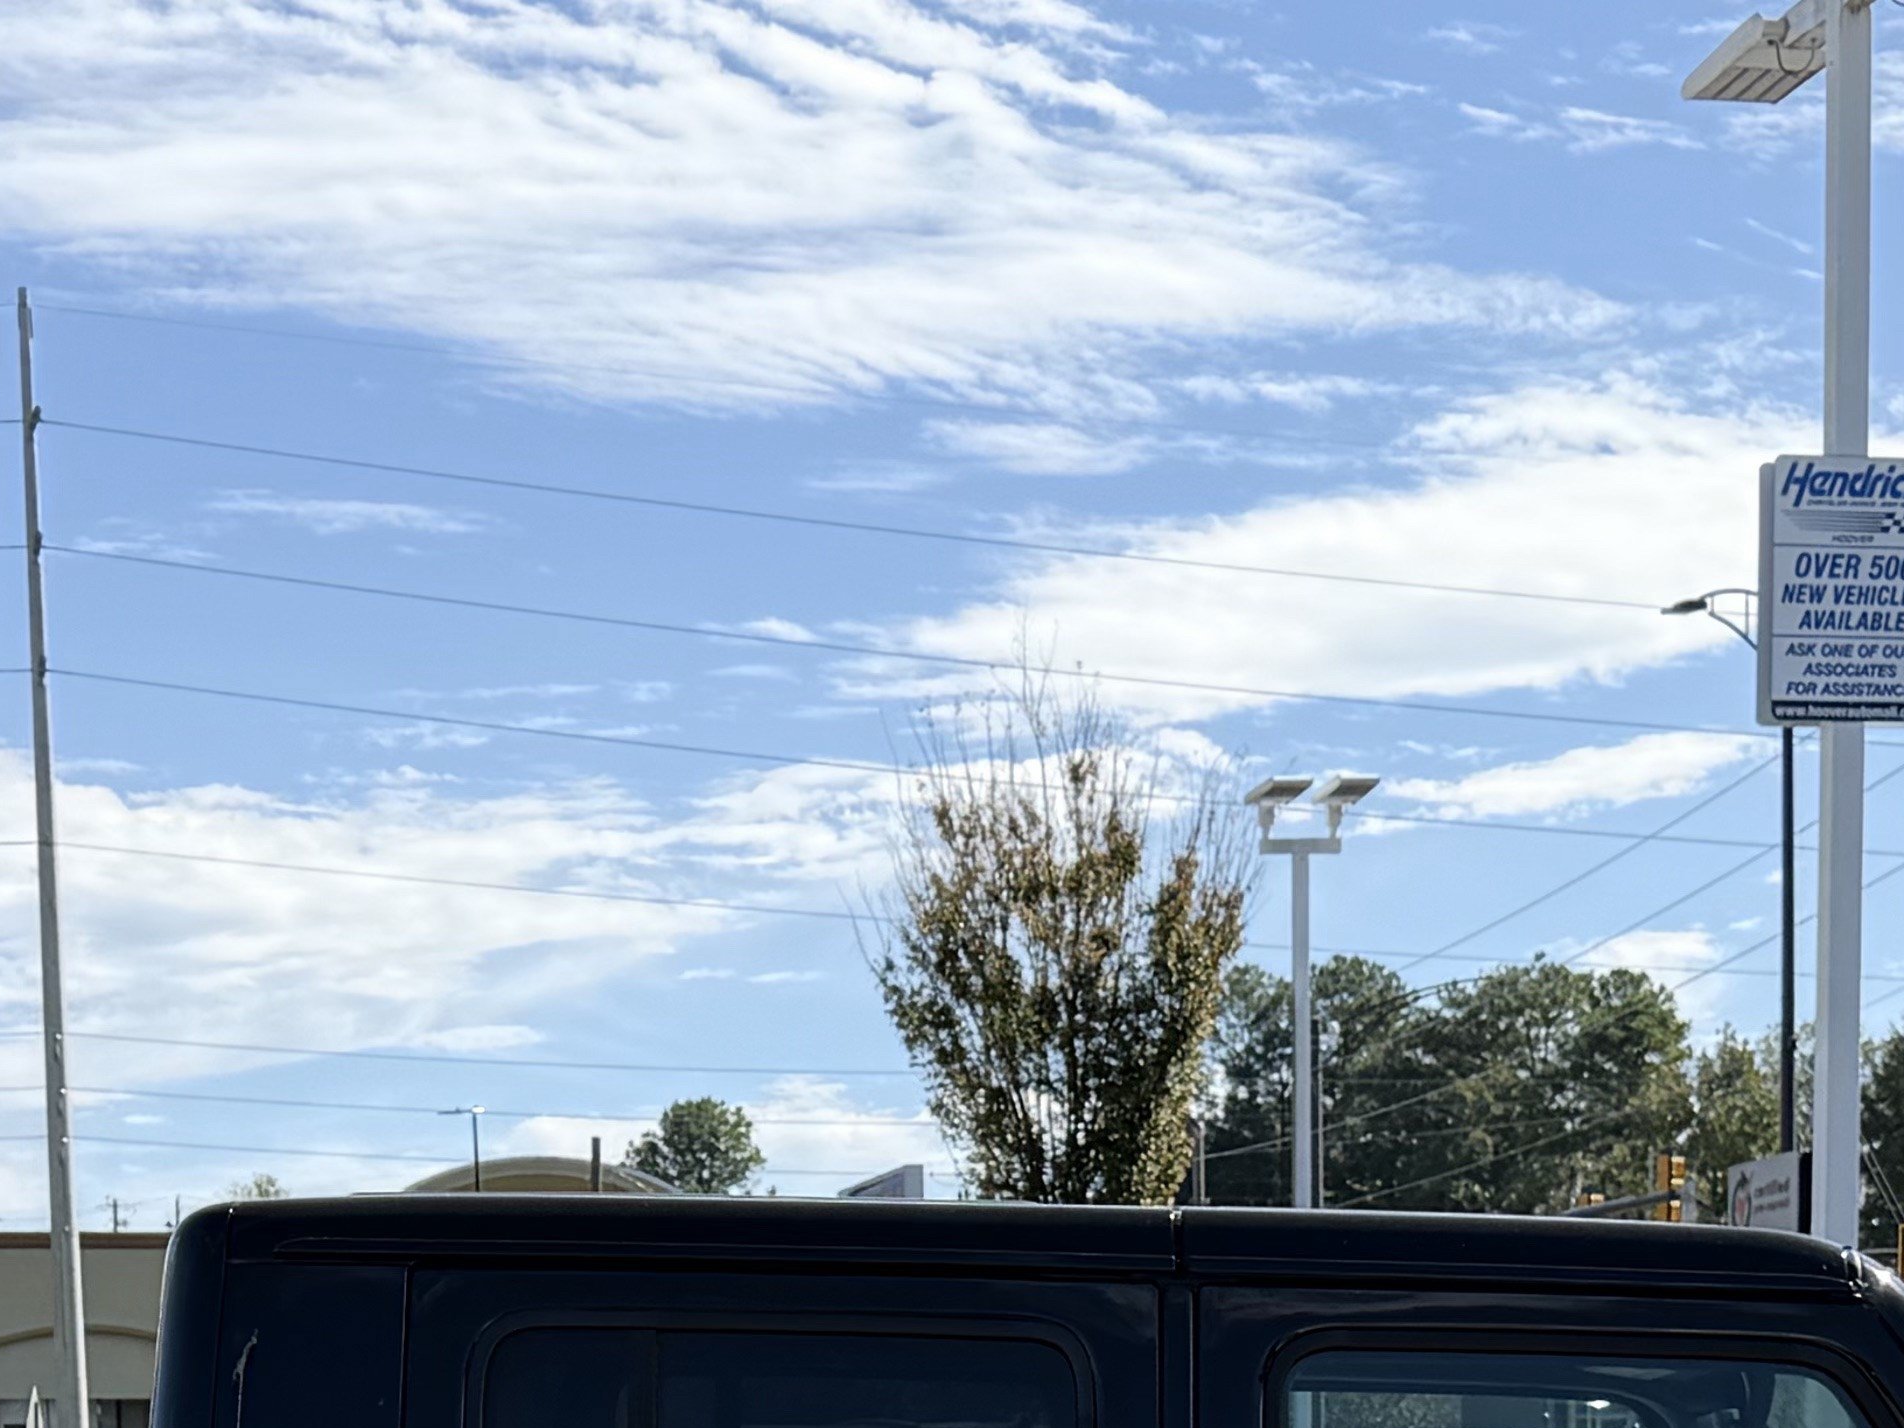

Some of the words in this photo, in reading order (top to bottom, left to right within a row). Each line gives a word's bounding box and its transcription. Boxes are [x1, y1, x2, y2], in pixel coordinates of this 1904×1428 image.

[1795, 552, 1862, 579] OVER
[1781, 583, 1827, 604] NEW
[1785, 642, 1817, 656] ASK
[1821, 643, 1854, 658] ONE
[1857, 644, 1880, 659] OF
[1802, 662, 1898, 678] ASSOCIATES
[1785, 681, 1817, 695] FOR
